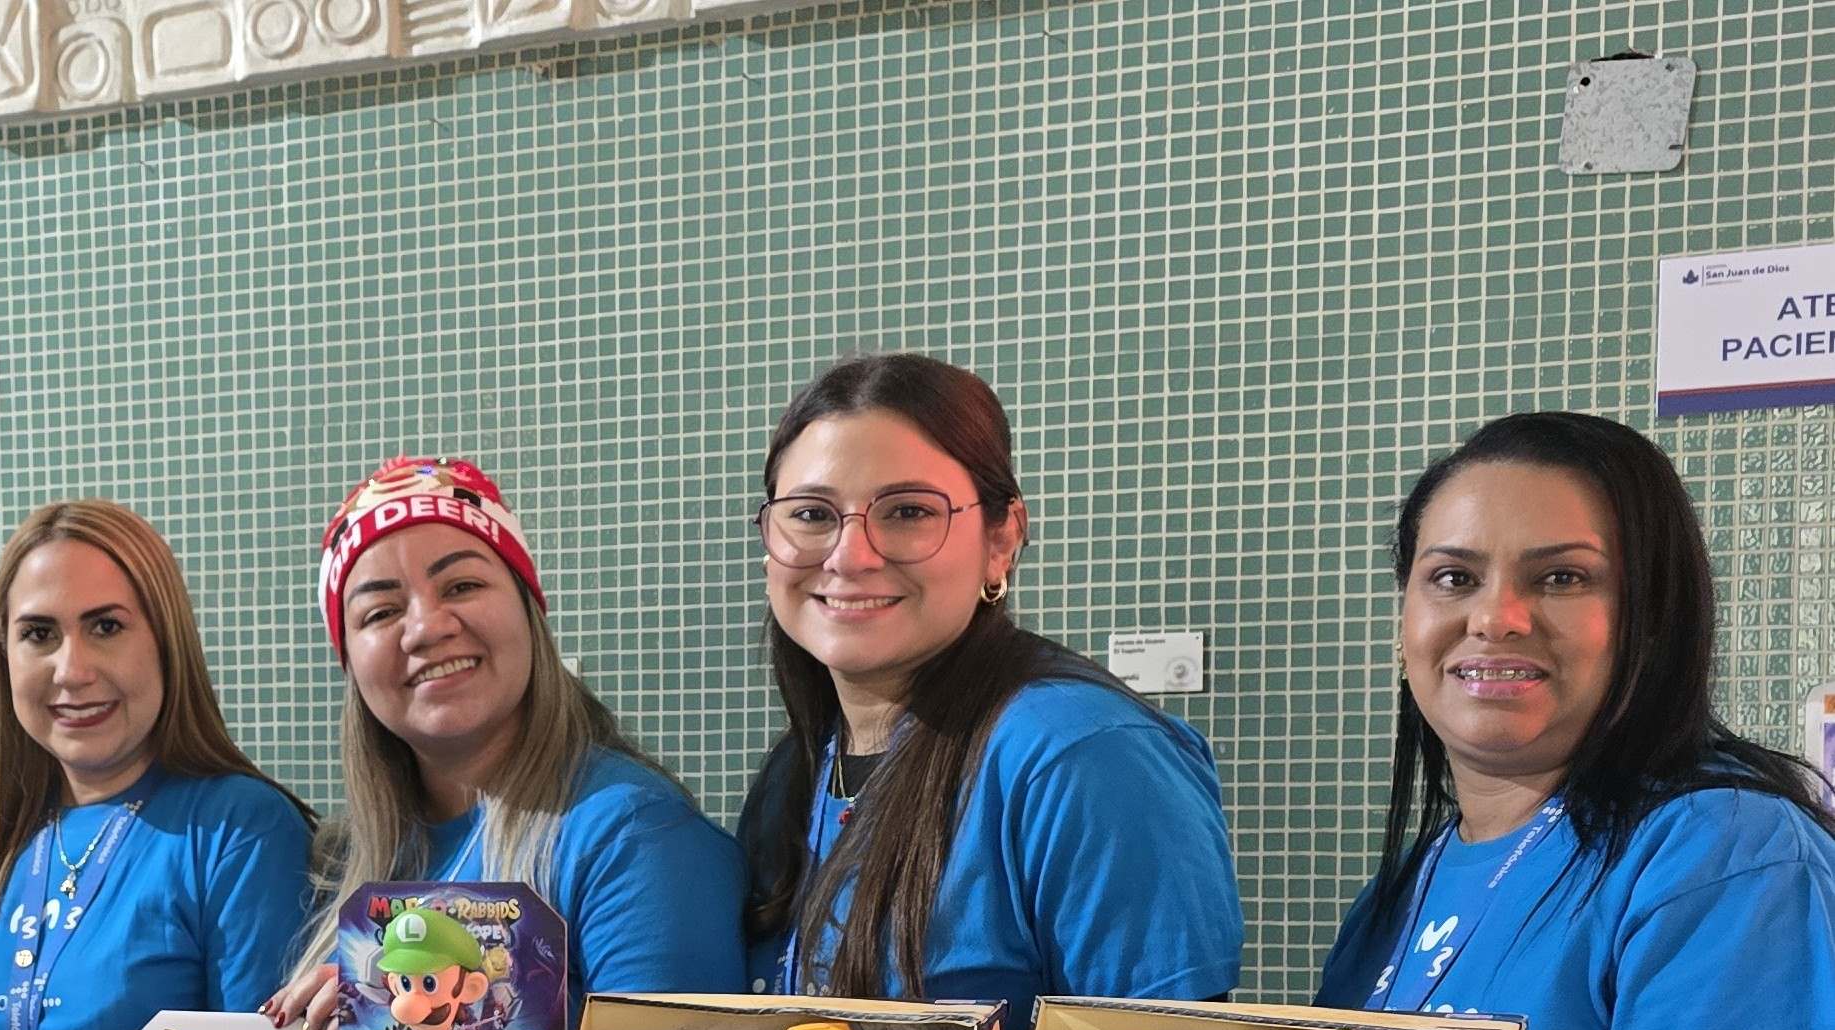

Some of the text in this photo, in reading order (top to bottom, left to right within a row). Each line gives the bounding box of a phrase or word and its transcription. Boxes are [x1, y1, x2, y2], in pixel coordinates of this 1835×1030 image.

[1706, 264, 1790, 280] San Juan de Dios
[1722, 330, 1835, 361] PACIE
[374, 496, 500, 545] DEER!
